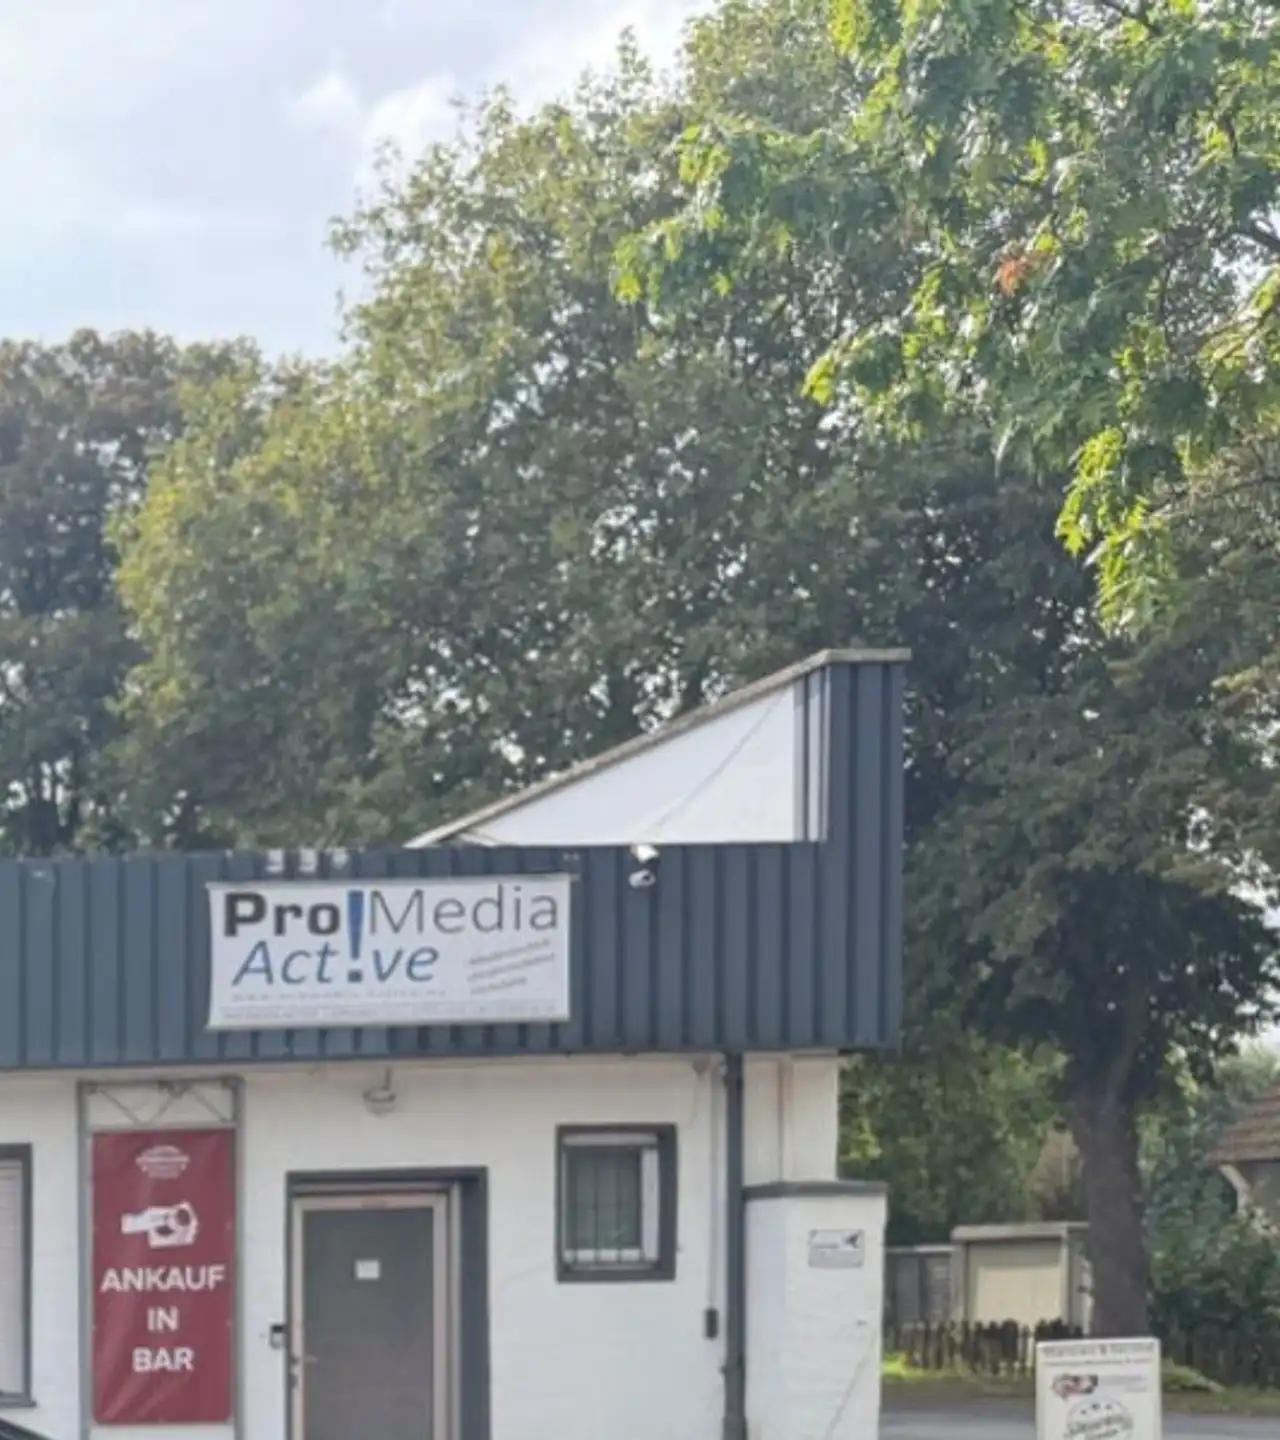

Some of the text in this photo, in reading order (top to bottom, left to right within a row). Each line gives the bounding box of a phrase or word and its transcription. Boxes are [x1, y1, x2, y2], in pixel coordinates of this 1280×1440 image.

[100, 1264, 225, 1292] ANKAUF
[147, 1305, 179, 1332] IN
[132, 1346, 195, 1372] BAR
